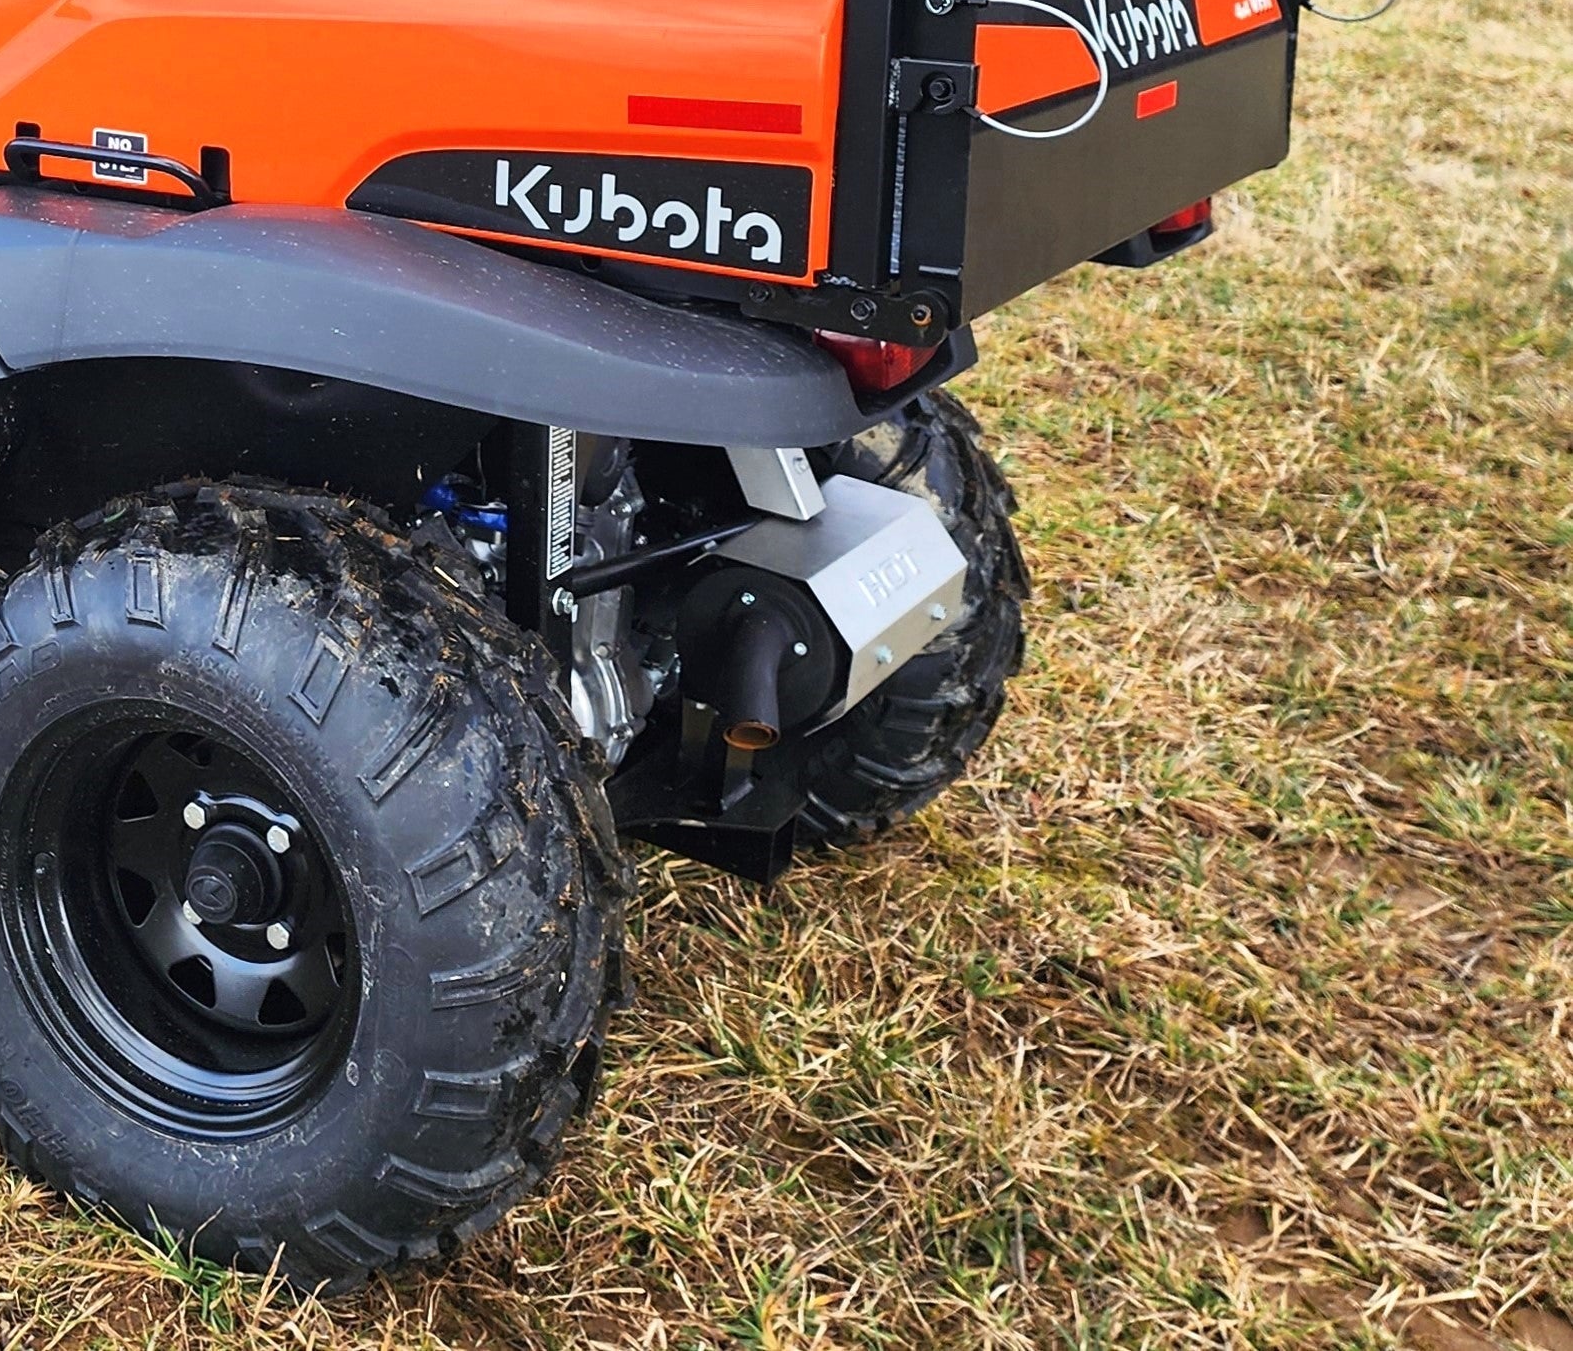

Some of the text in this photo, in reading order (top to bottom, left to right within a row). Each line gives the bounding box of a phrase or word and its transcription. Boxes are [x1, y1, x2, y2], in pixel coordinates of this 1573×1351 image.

[108, 136, 132, 152] NO
[495, 158, 782, 264] Kubota
[857, 546, 920, 608] HOT
